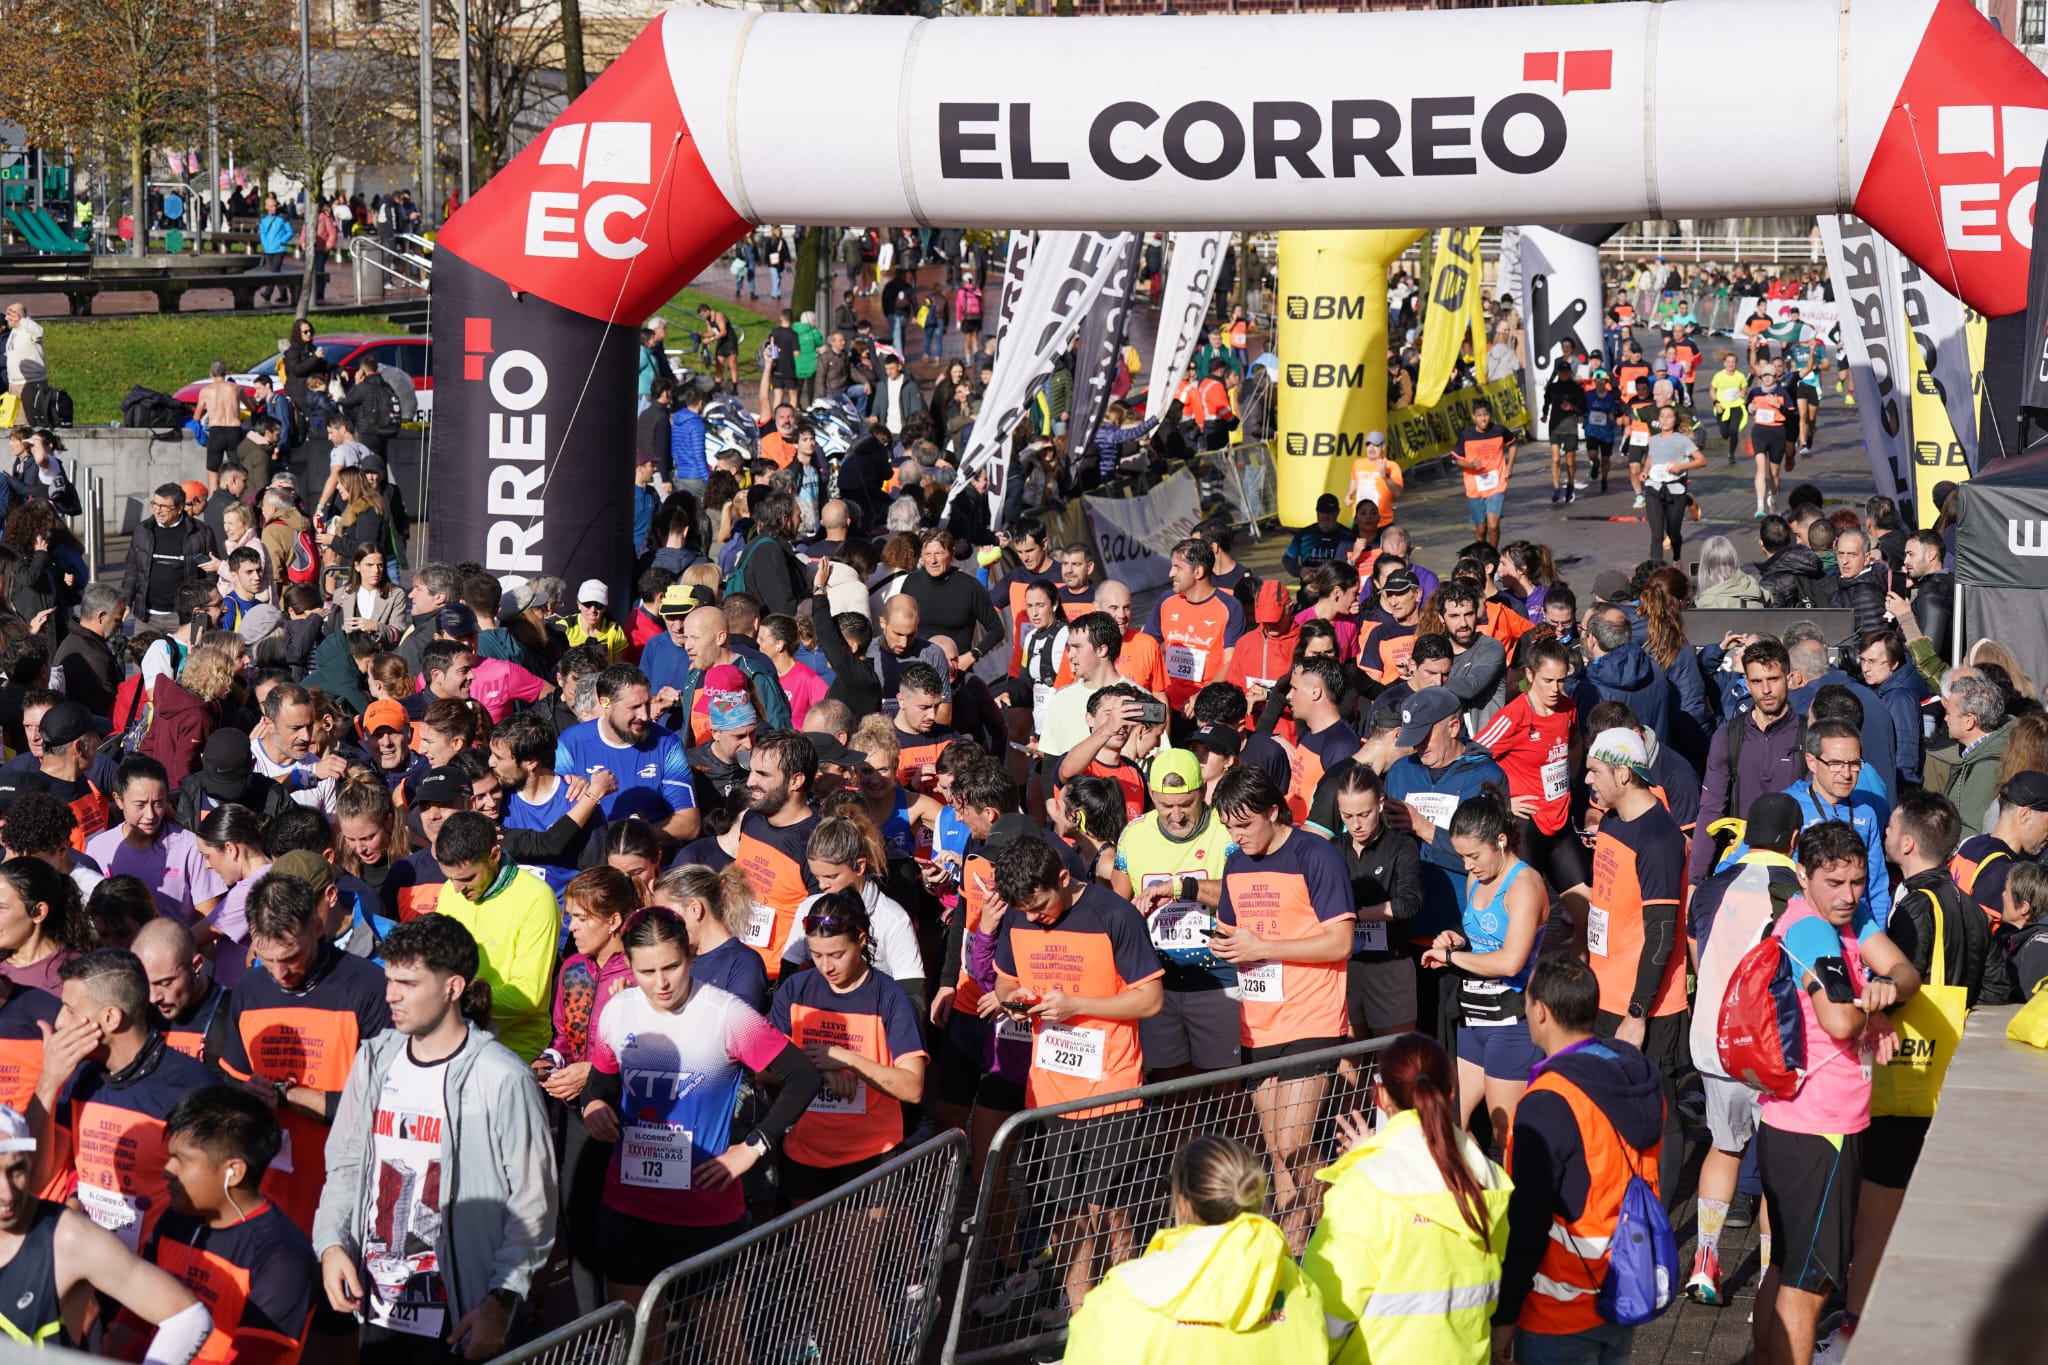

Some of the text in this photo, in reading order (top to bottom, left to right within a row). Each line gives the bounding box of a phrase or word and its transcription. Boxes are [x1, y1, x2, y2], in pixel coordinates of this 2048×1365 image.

[939, 92, 1567, 181] EL CORREO
[525, 192, 648, 260] EC
[1312, 296, 1365, 320] BM
[1312, 364, 1365, 388] BM
[1312, 432, 1365, 456] BM
[1244, 978, 1266, 992] 2236
[1045, 1034, 1069, 1050] XXXVII
[1900, 1038, 1936, 1057] BM
[1055, 1050, 1083, 1067] 2237
[623, 1068, 692, 1101] KTT
[642, 1134, 672, 1142] CORREO
[628, 1144, 652, 1159] XXXVII
[642, 1160, 662, 1177] 173
[96, 1194, 124, 1206] CORREO
